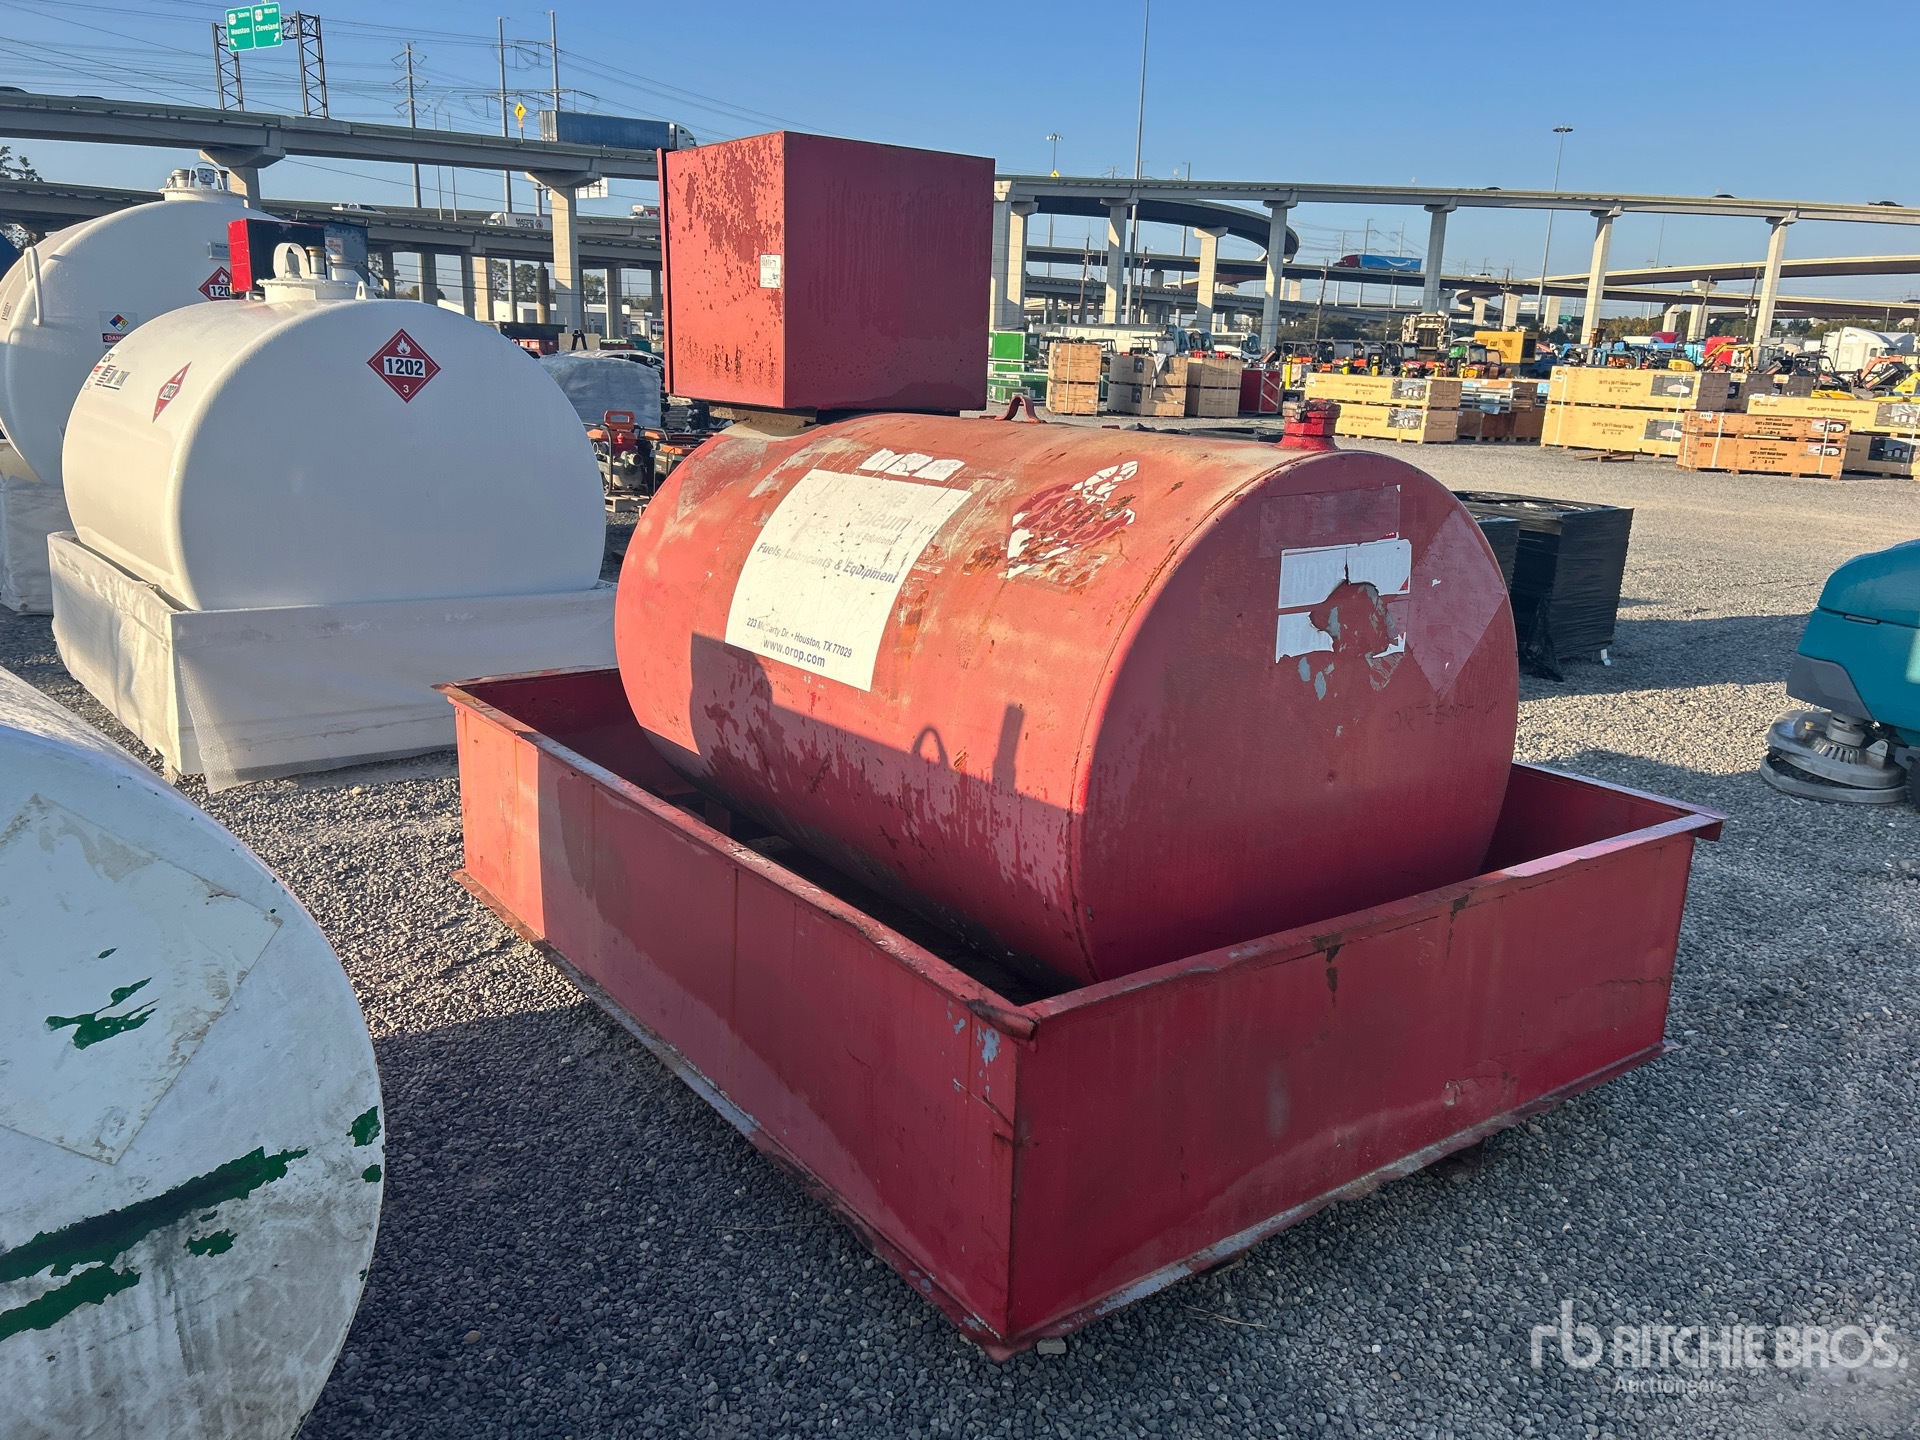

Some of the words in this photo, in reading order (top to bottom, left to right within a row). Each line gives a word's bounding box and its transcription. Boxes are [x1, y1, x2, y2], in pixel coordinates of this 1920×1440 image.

[255, 22, 279, 32] Cleveland
[210, 285, 231, 297] 120
[385, 357, 424, 377] 1202
[402, 384, 410, 394] 3
[757, 541, 782, 559] Fuels,
[784, 547, 832, 569] Lubricants
[834, 558, 843, 571] &
[843, 560, 900, 584] Equipment
[746, 616, 758, 628] 223
[757, 620, 780, 638] Mcarty
[794, 632, 821, 651] Houston,
[822, 640, 833, 653] TX
[833, 643, 853, 659] 77029
[762, 638, 827, 668] www.orop.com
